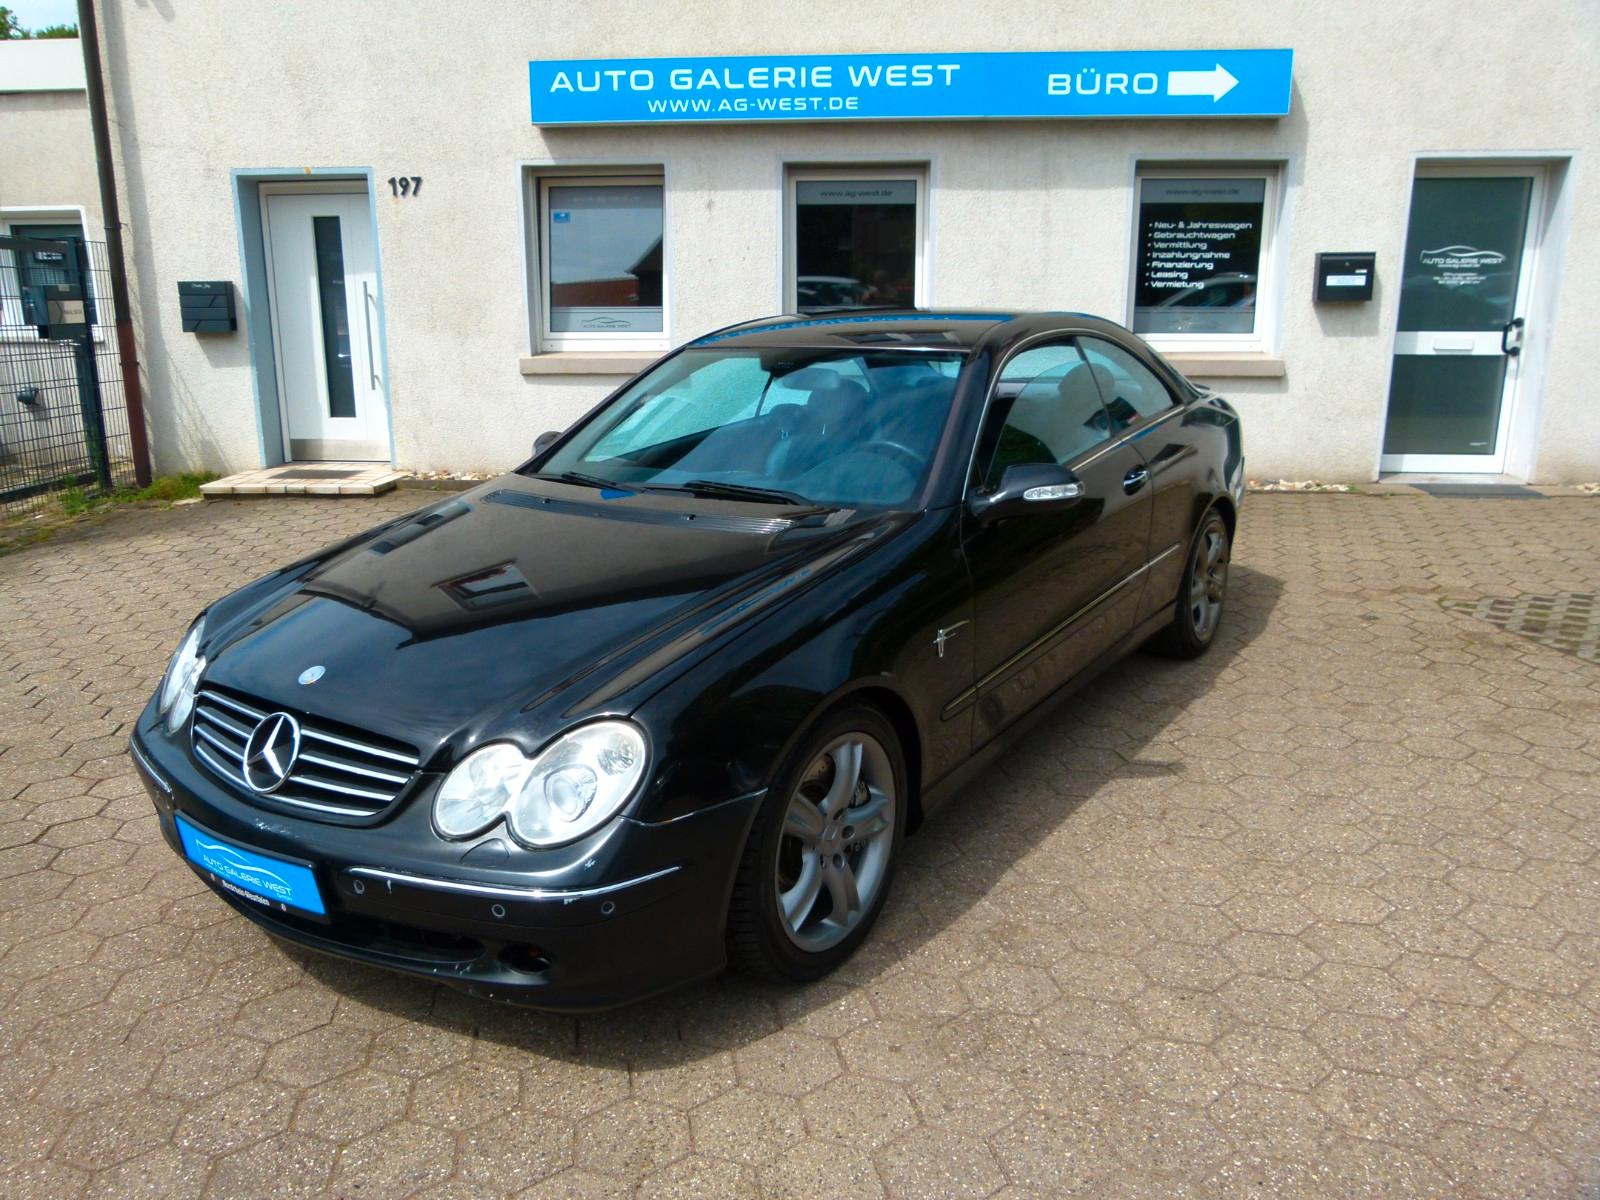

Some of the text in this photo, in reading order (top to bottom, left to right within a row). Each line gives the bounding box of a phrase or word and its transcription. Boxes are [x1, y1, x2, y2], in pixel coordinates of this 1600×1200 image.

[550, 64, 960, 93] AUTO GALERIE WEST
[1048, 67, 1158, 95] BÜRO
[648, 96, 859, 113] WWW.AG-WEST.DE
[388, 177, 422, 198] 197
[1154, 220, 1253, 231] Neu- & Jahreswagen
[1153, 231, 1236, 240] Gebrauchtwagen
[1153, 241, 1208, 250] Vermittlung
[1152, 251, 1231, 260] Inzahlungnahme
[1151, 260, 1214, 270] Finanzierung
[1150, 270, 1189, 280] Leasing
[1150, 280, 1205, 290] Vermietung
[262, 880, 292, 896] WEST
